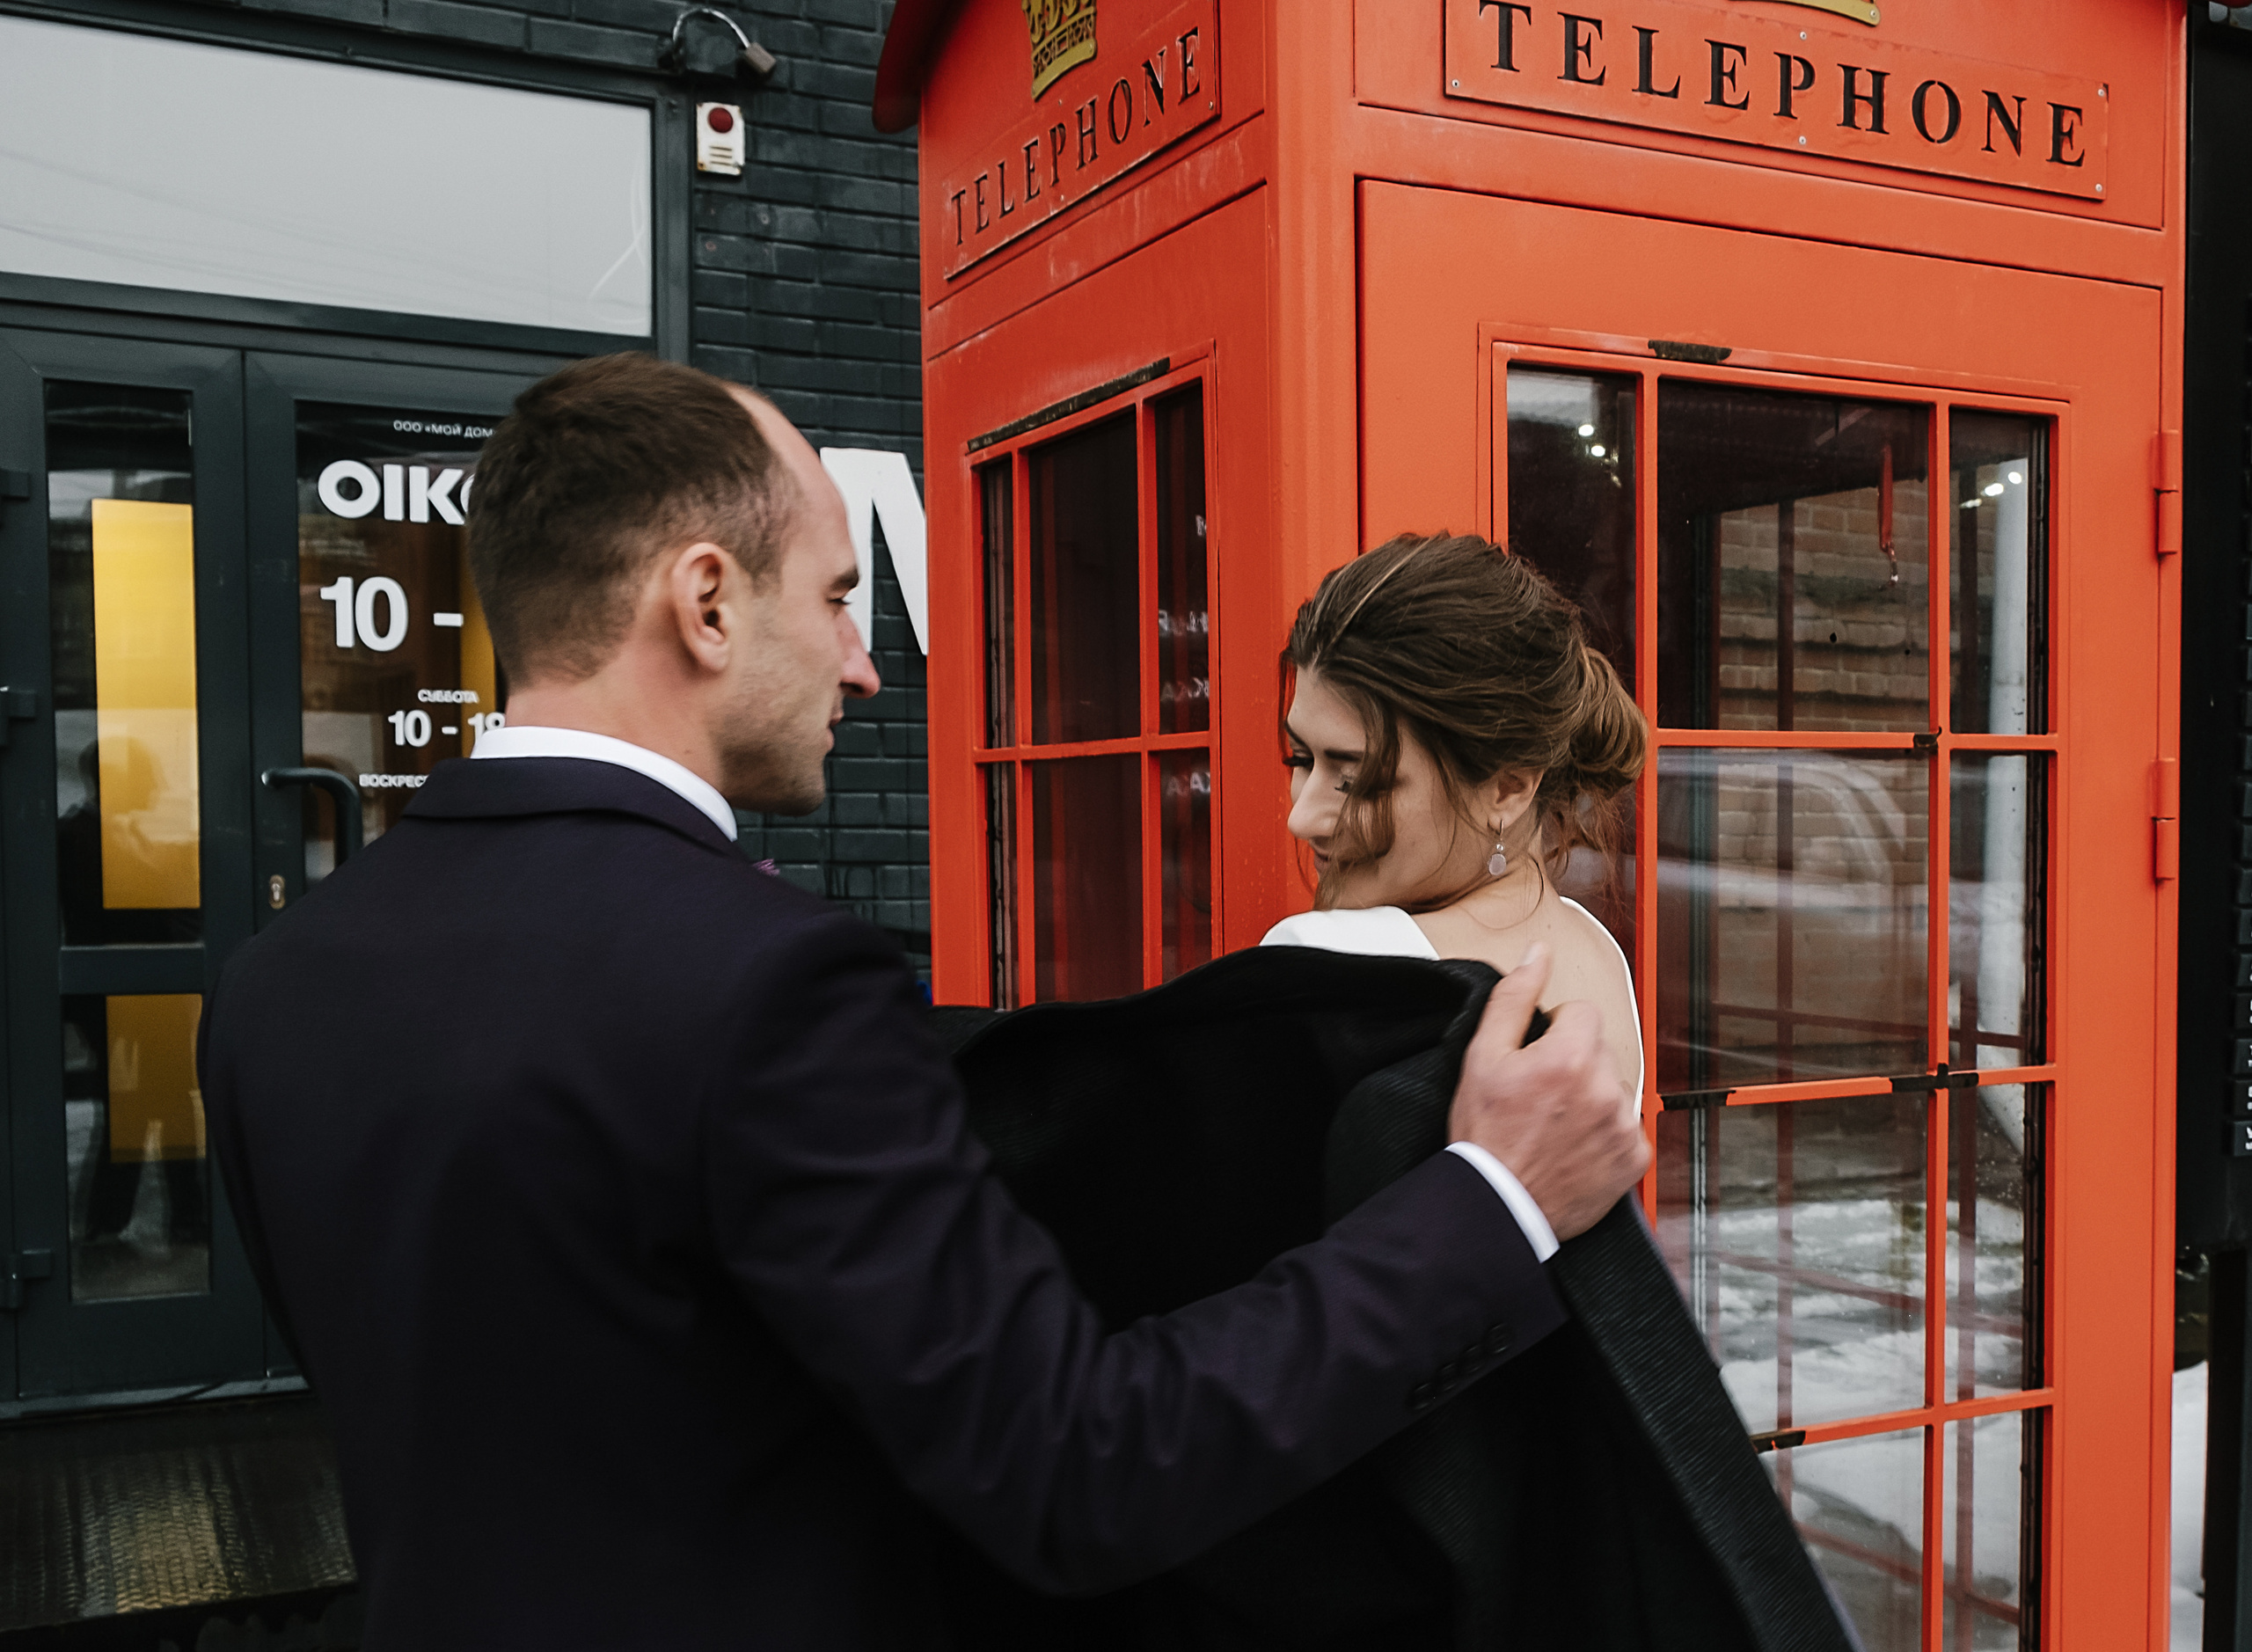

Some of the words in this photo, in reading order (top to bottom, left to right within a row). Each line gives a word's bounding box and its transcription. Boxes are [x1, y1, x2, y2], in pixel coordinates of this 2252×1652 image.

[1478, 0, 2087, 168] TELEPHONE
[950, 26, 1202, 246] TELEPHONE
[393, 420, 421, 433] ООО
[318, 459, 475, 525] OIK
[320, 576, 408, 652] 10
[418, 689, 479, 704] СУББОТА
[388, 710, 432, 747] 10
[359, 773, 429, 788] ВОСКРЕС
